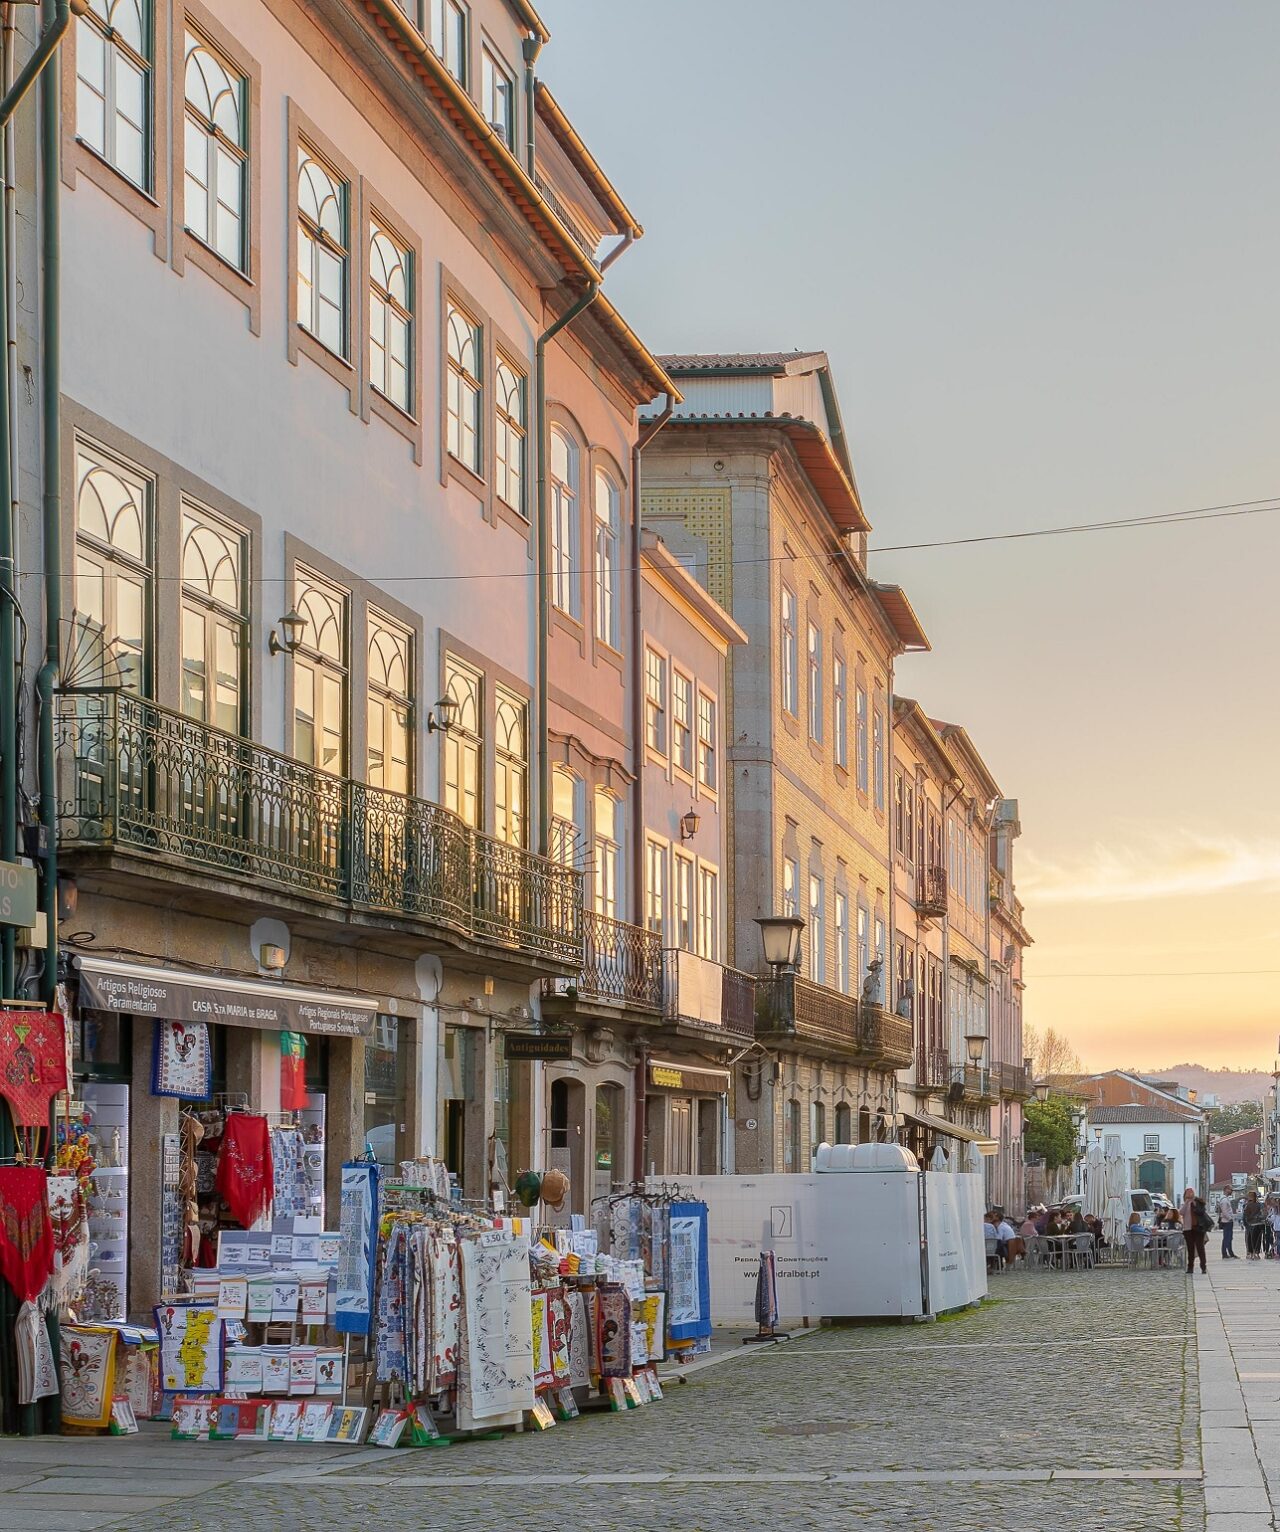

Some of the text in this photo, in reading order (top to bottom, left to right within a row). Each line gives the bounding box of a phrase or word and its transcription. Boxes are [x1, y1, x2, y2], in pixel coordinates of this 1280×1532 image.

[97, 978, 167, 998] Artigos Religiosos
[108, 995, 157, 1012] Paramentaria
[192, 1001, 212, 1012] CASA
[227, 1005, 248, 1017] MARIA
[256, 1008, 278, 1020] BRAGA
[298, 1005, 316, 1018] Artigos
[317, 1007, 340, 1020] Regionais
[485, 1234, 501, 1243] 3.50
